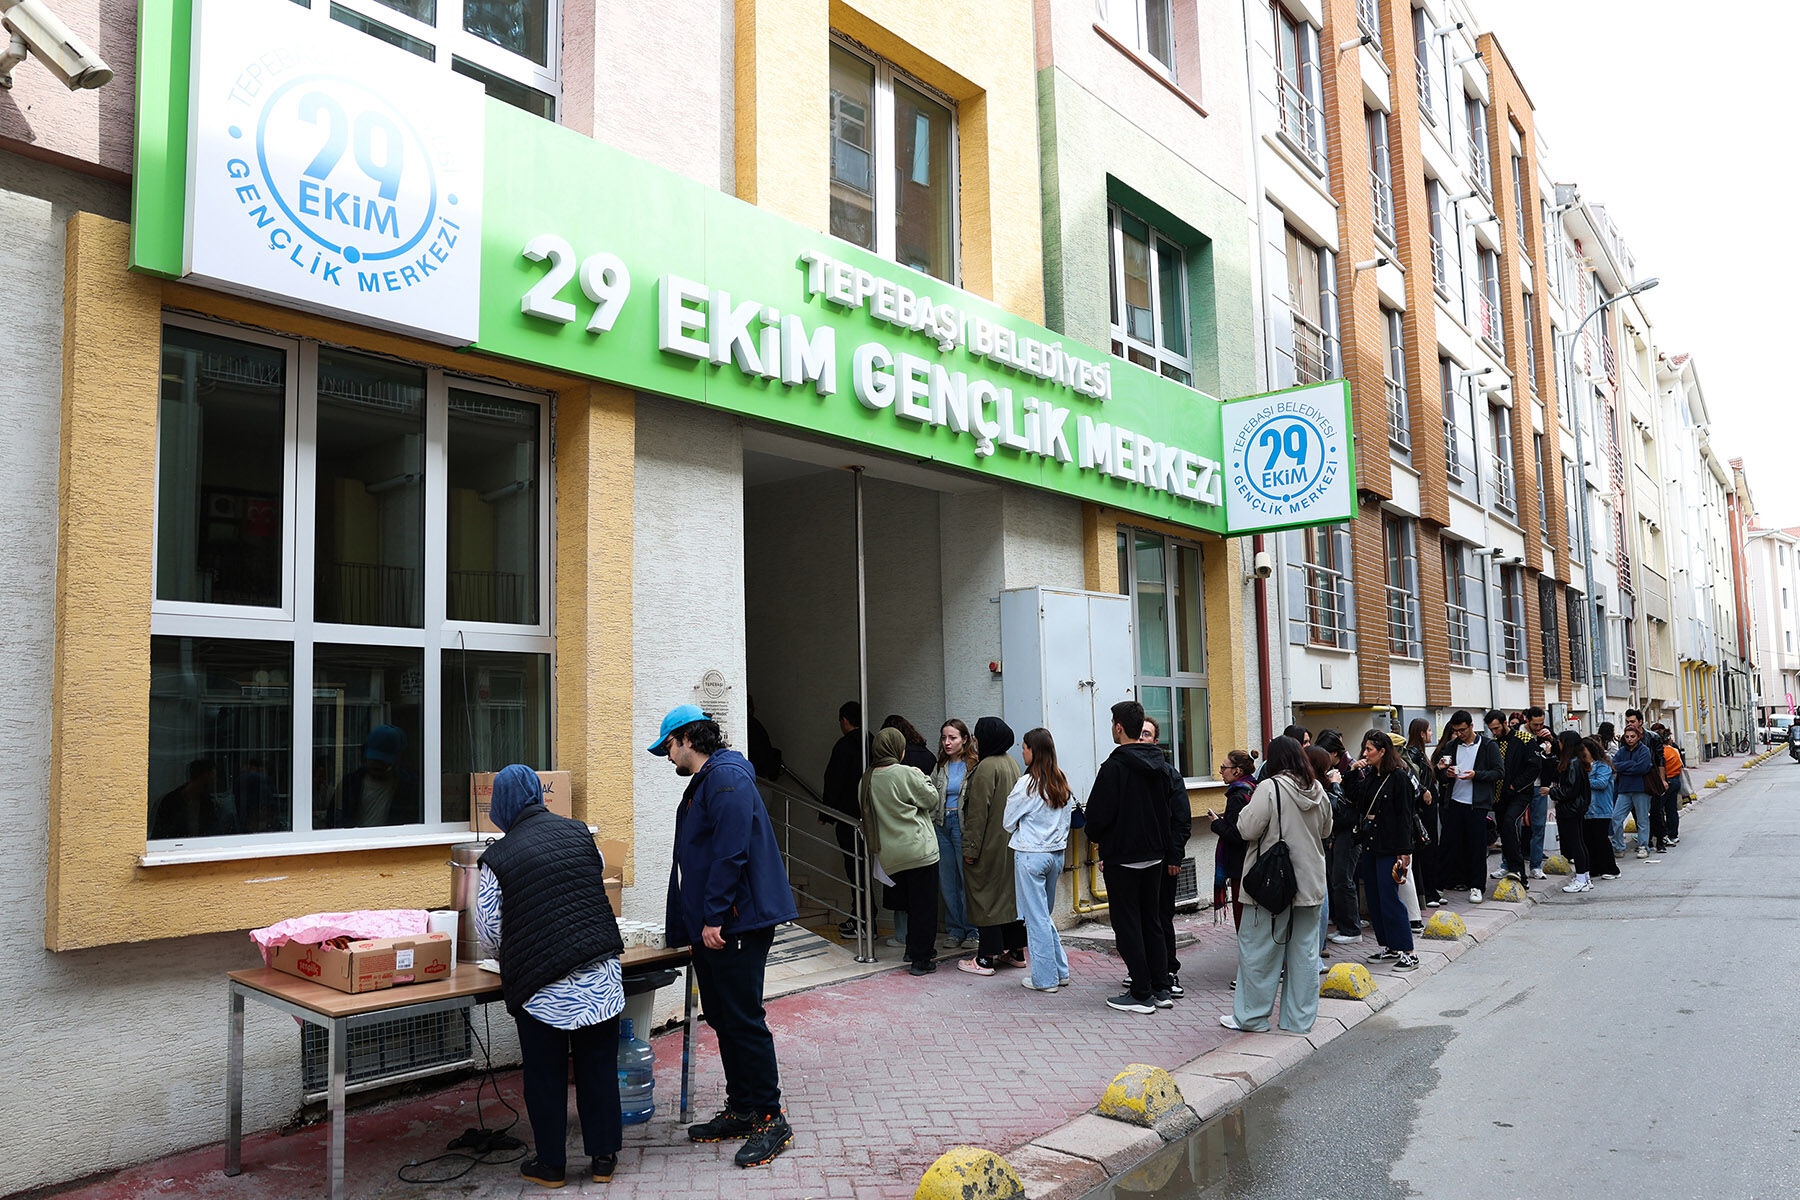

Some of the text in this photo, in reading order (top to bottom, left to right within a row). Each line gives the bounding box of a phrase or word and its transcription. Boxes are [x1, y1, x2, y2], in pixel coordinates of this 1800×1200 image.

[298, 91, 403, 202] 29
[226, 157, 461, 293] GENÇLİK MERKEZİ
[521, 233, 631, 335] 29
[801, 249, 1112, 401] TEPEBAŞI BELEDİYESİ
[1232, 401, 1338, 454] TEPEBAŞI BELEDİYESİ
[1259, 423, 1308, 471] 29
[1233, 460, 1338, 516] GENÇLİK MERKEZİ
